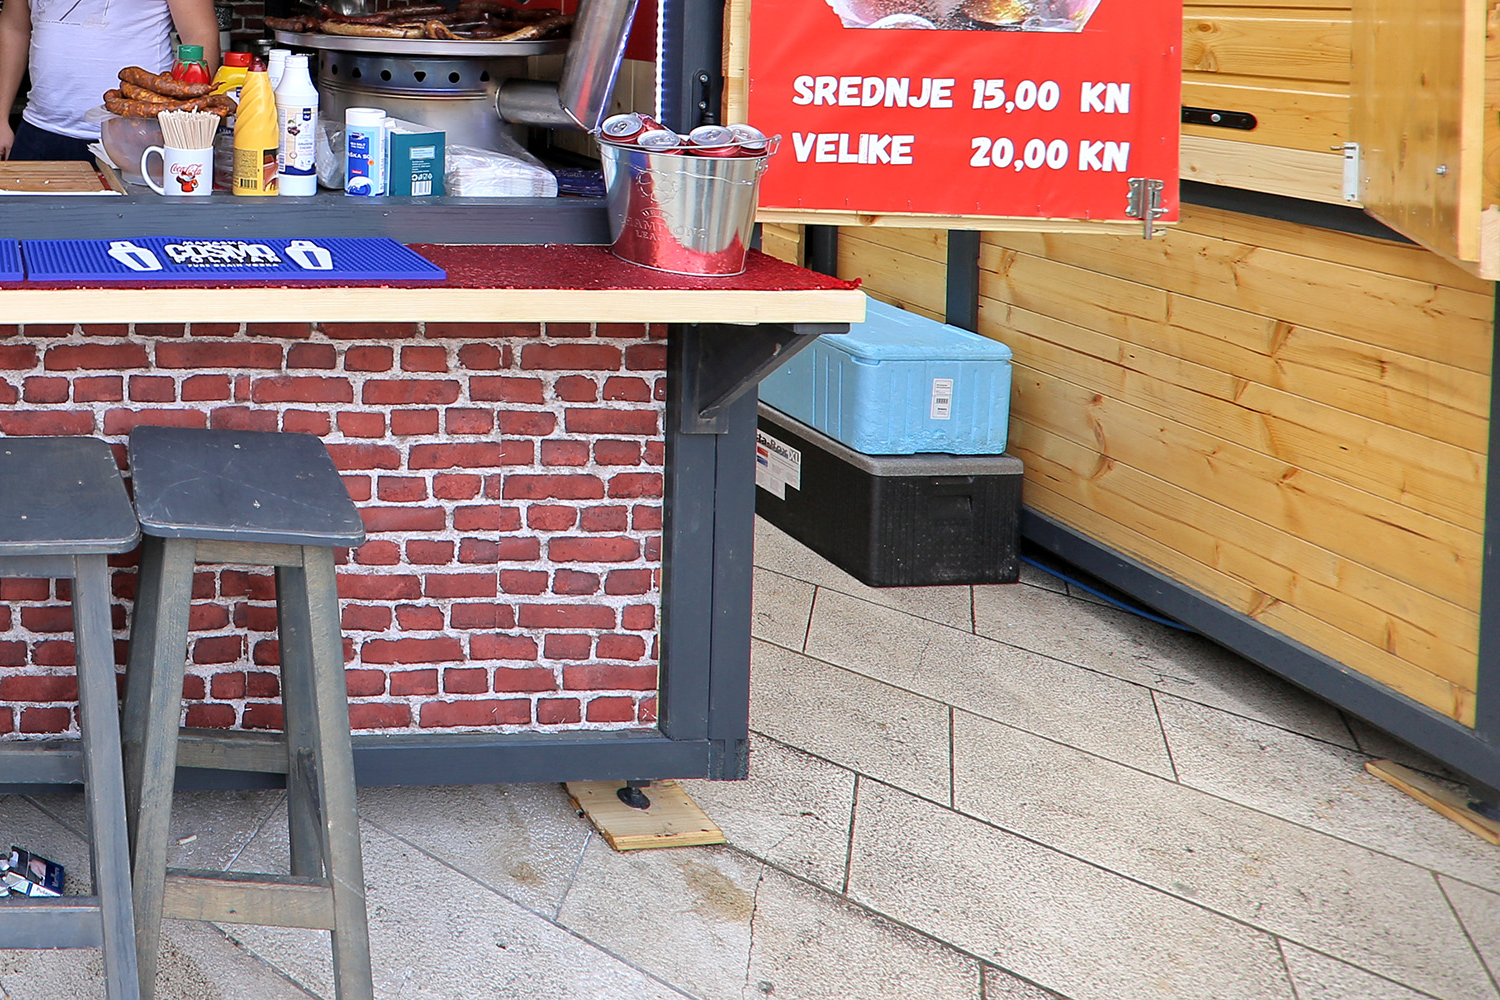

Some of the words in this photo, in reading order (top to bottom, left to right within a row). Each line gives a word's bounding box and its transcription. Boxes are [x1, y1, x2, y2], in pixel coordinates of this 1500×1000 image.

[792, 75, 954, 108] SREDNJE
[972, 79, 1060, 116] 15,00
[1079, 82, 1131, 115] KN
[792, 132, 914, 166] VELIKE
[969, 136, 1069, 172] 20,00
[1078, 139, 1131, 173] KN
[164, 244, 278, 258] COSMO
